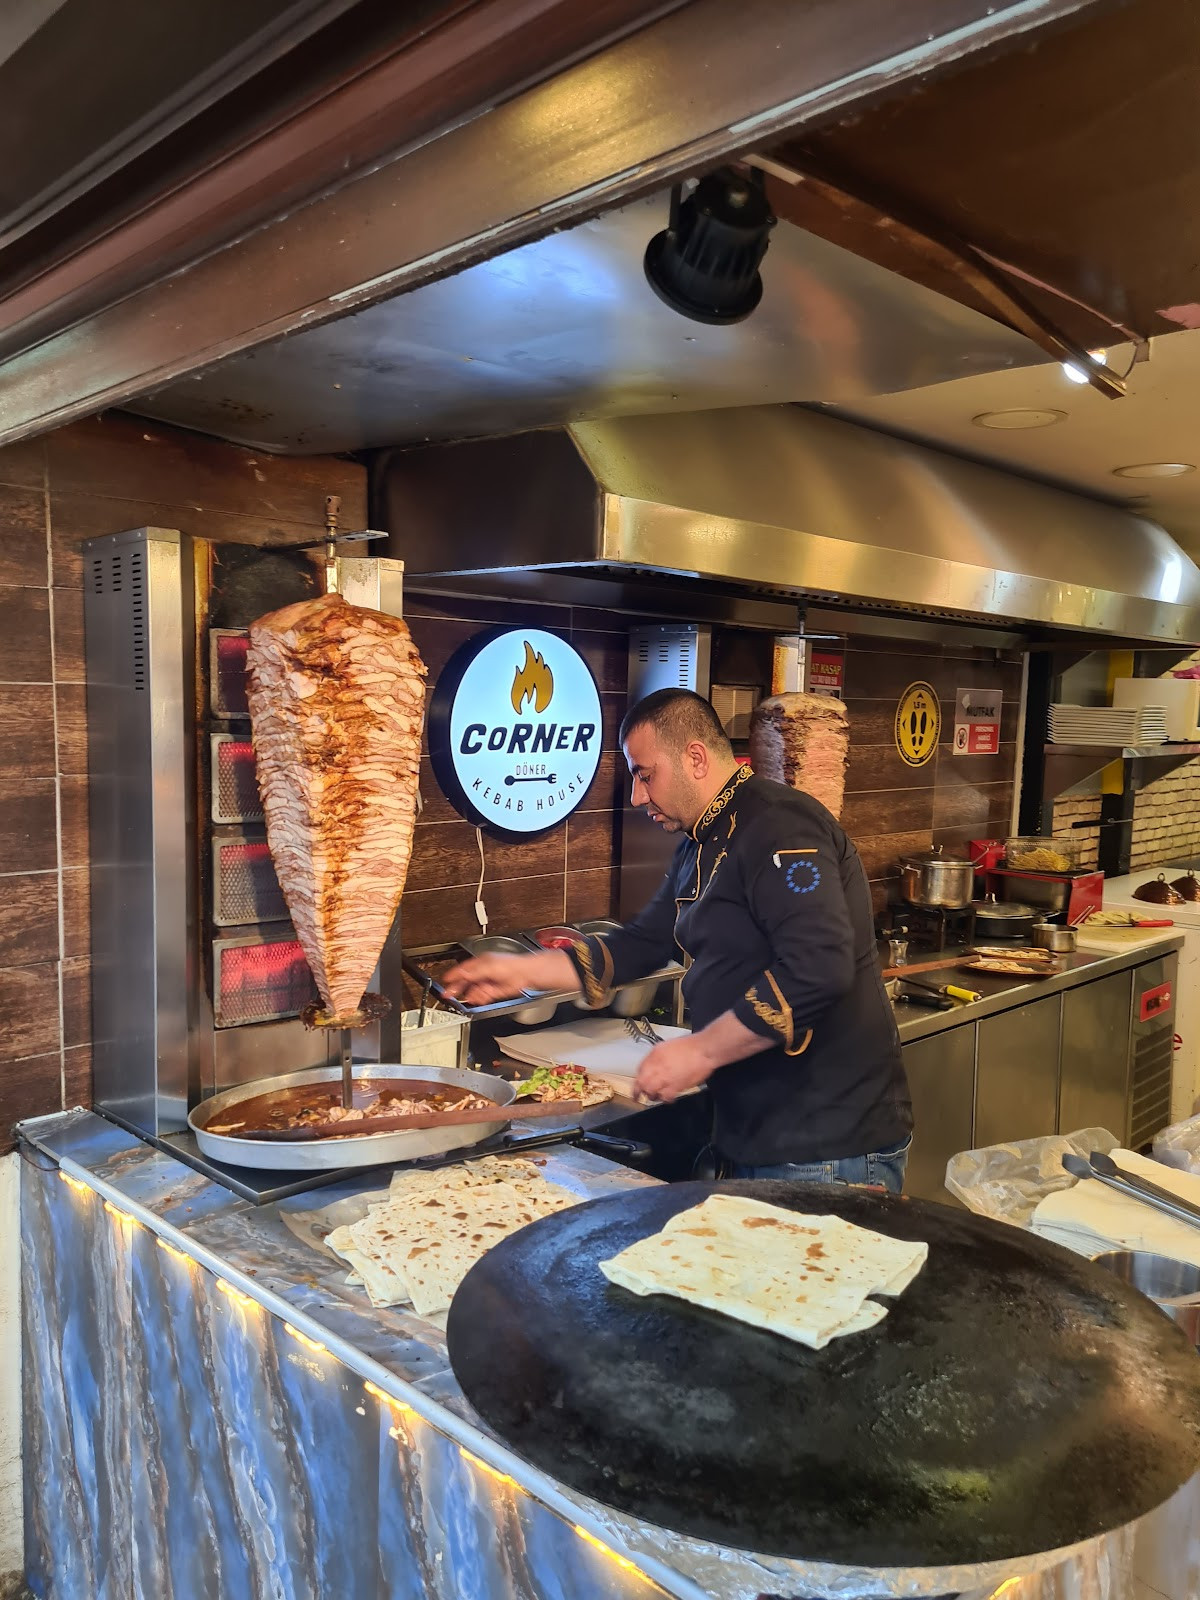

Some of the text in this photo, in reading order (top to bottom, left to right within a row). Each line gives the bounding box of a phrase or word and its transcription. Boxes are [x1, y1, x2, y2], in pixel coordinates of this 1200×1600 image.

[966, 706, 995, 718] MUTFAK
[459, 723, 596, 755] CORNER
[515, 762, 547, 776] DÖNER
[472, 773, 585, 812] KEBAB HOUSE
